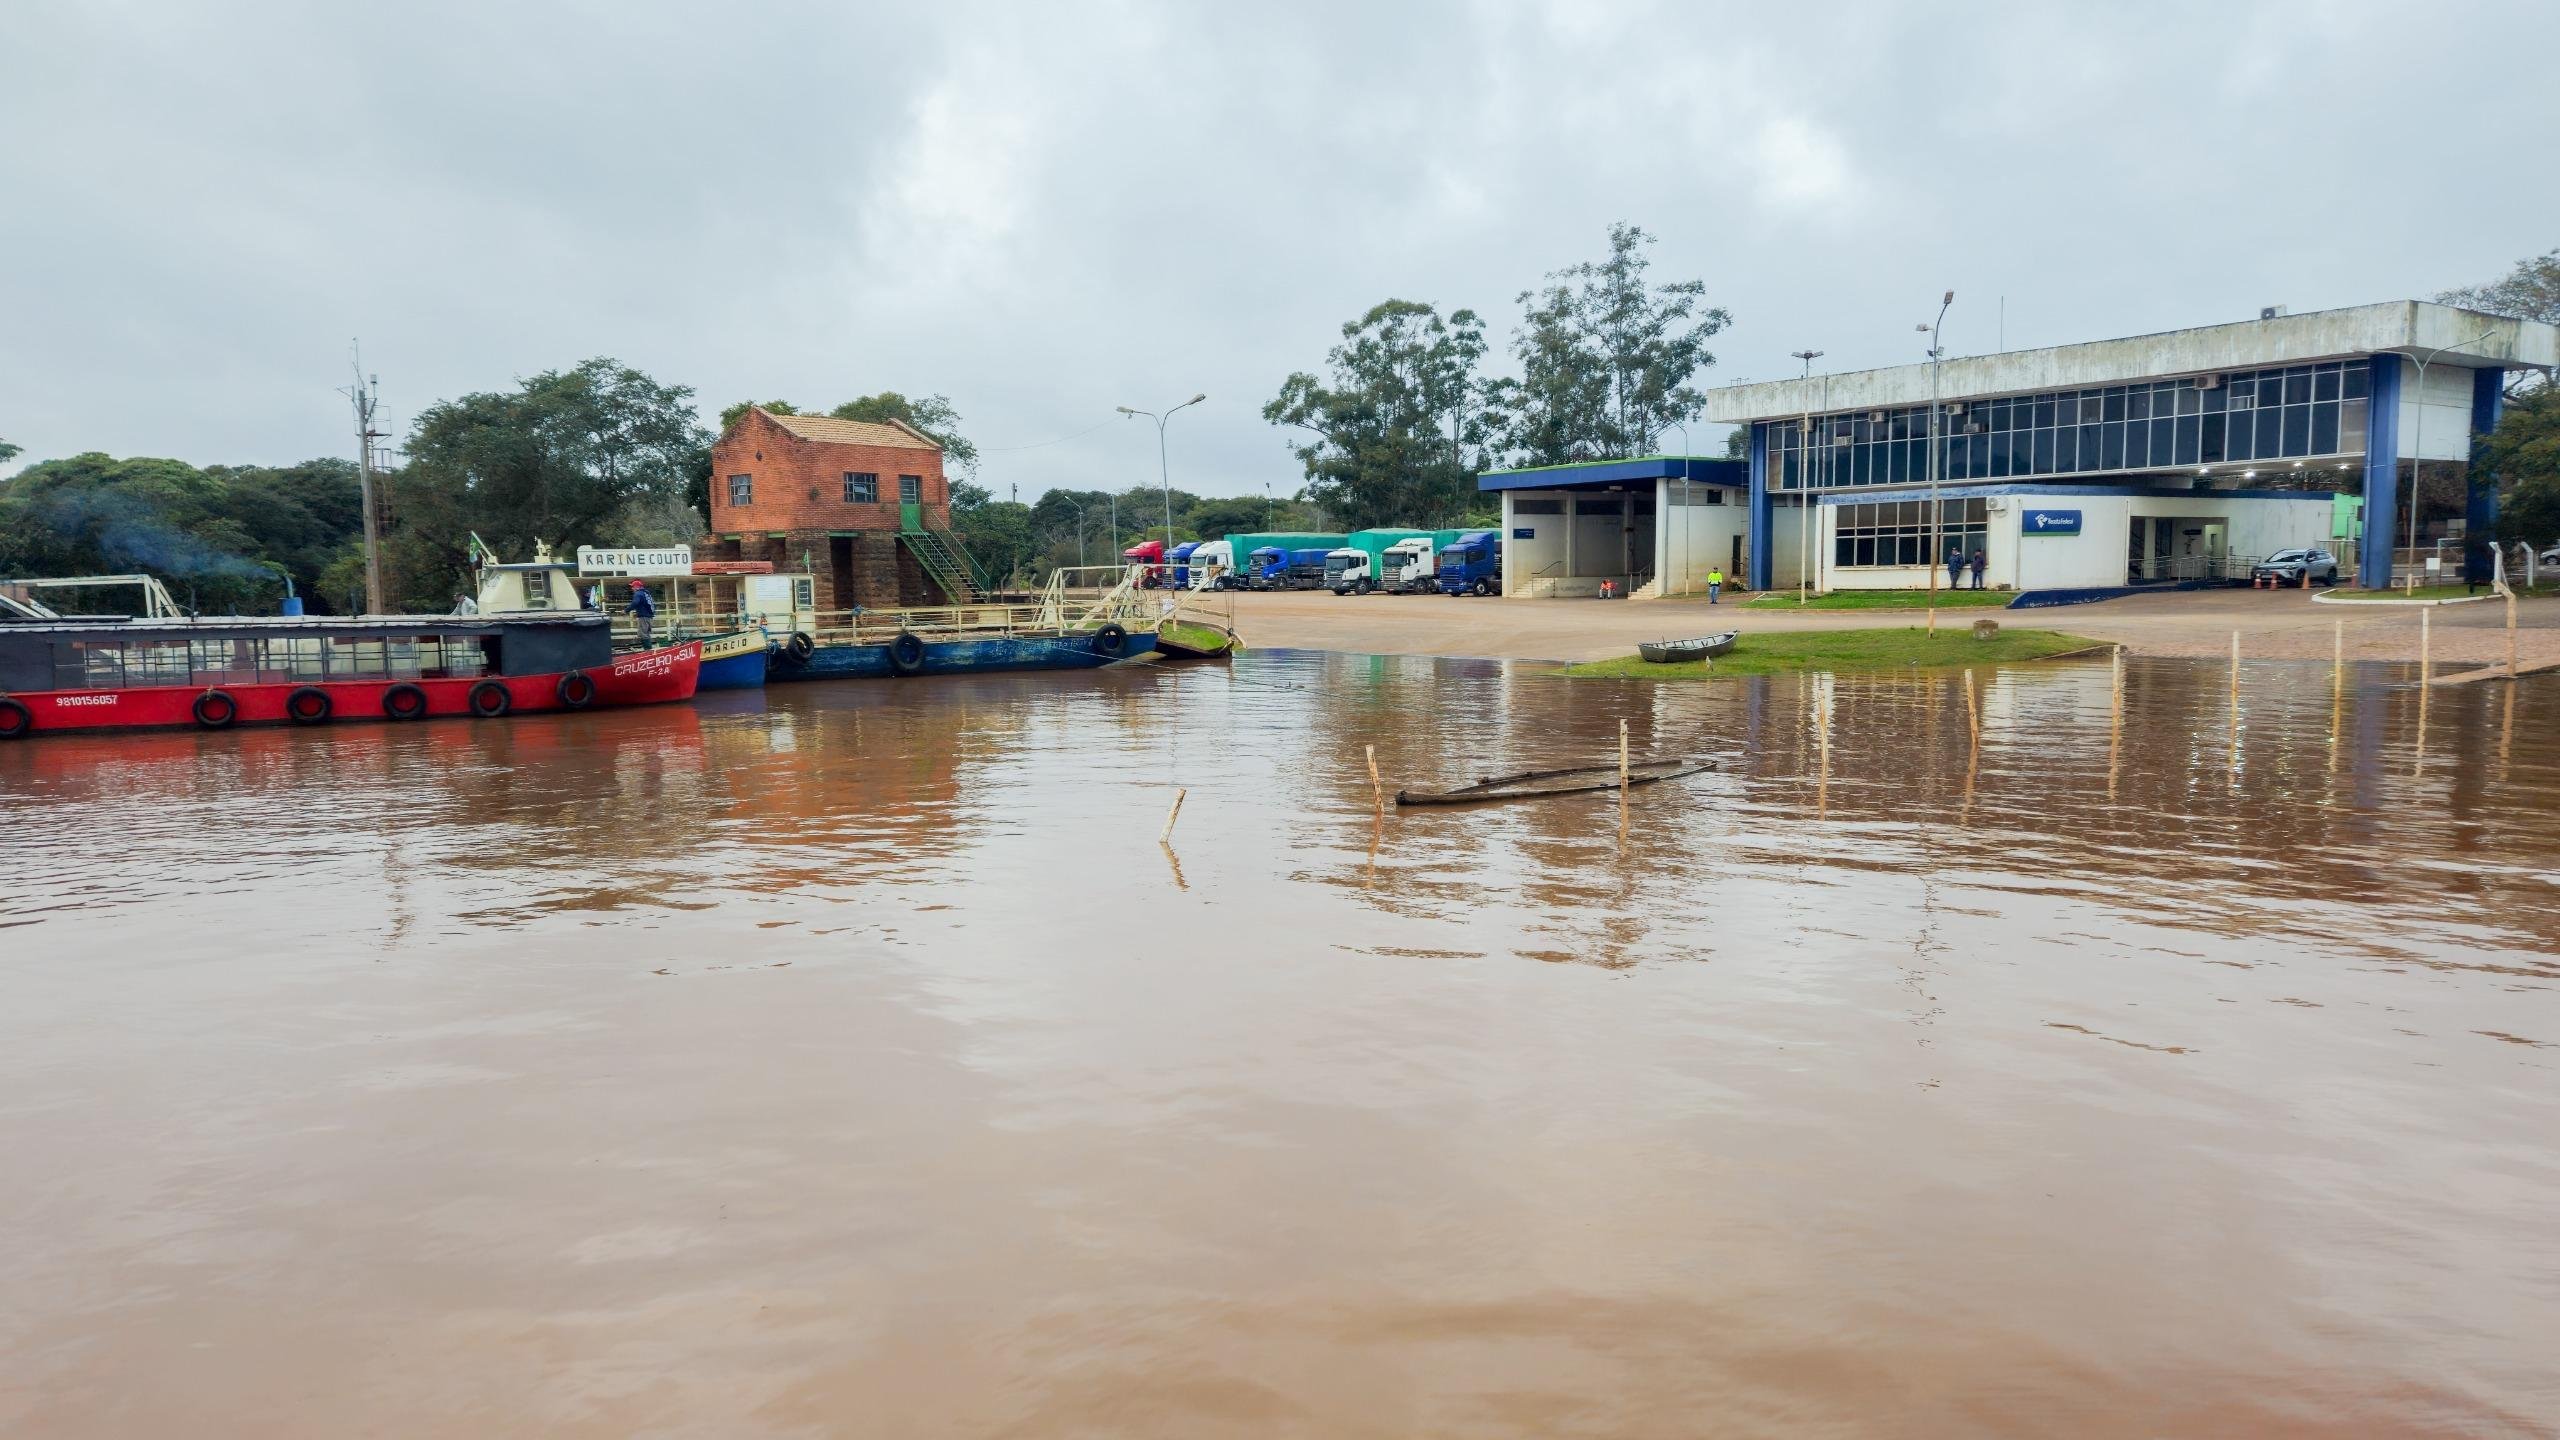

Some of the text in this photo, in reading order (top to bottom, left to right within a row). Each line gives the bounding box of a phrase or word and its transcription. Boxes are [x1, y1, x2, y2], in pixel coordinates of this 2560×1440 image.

[704, 638, 747, 654] MARCIO
[614, 654, 672, 676] CRUZEIRO
[679, 646, 696, 661] SUL
[56, 695, 118, 706] 9810156057
